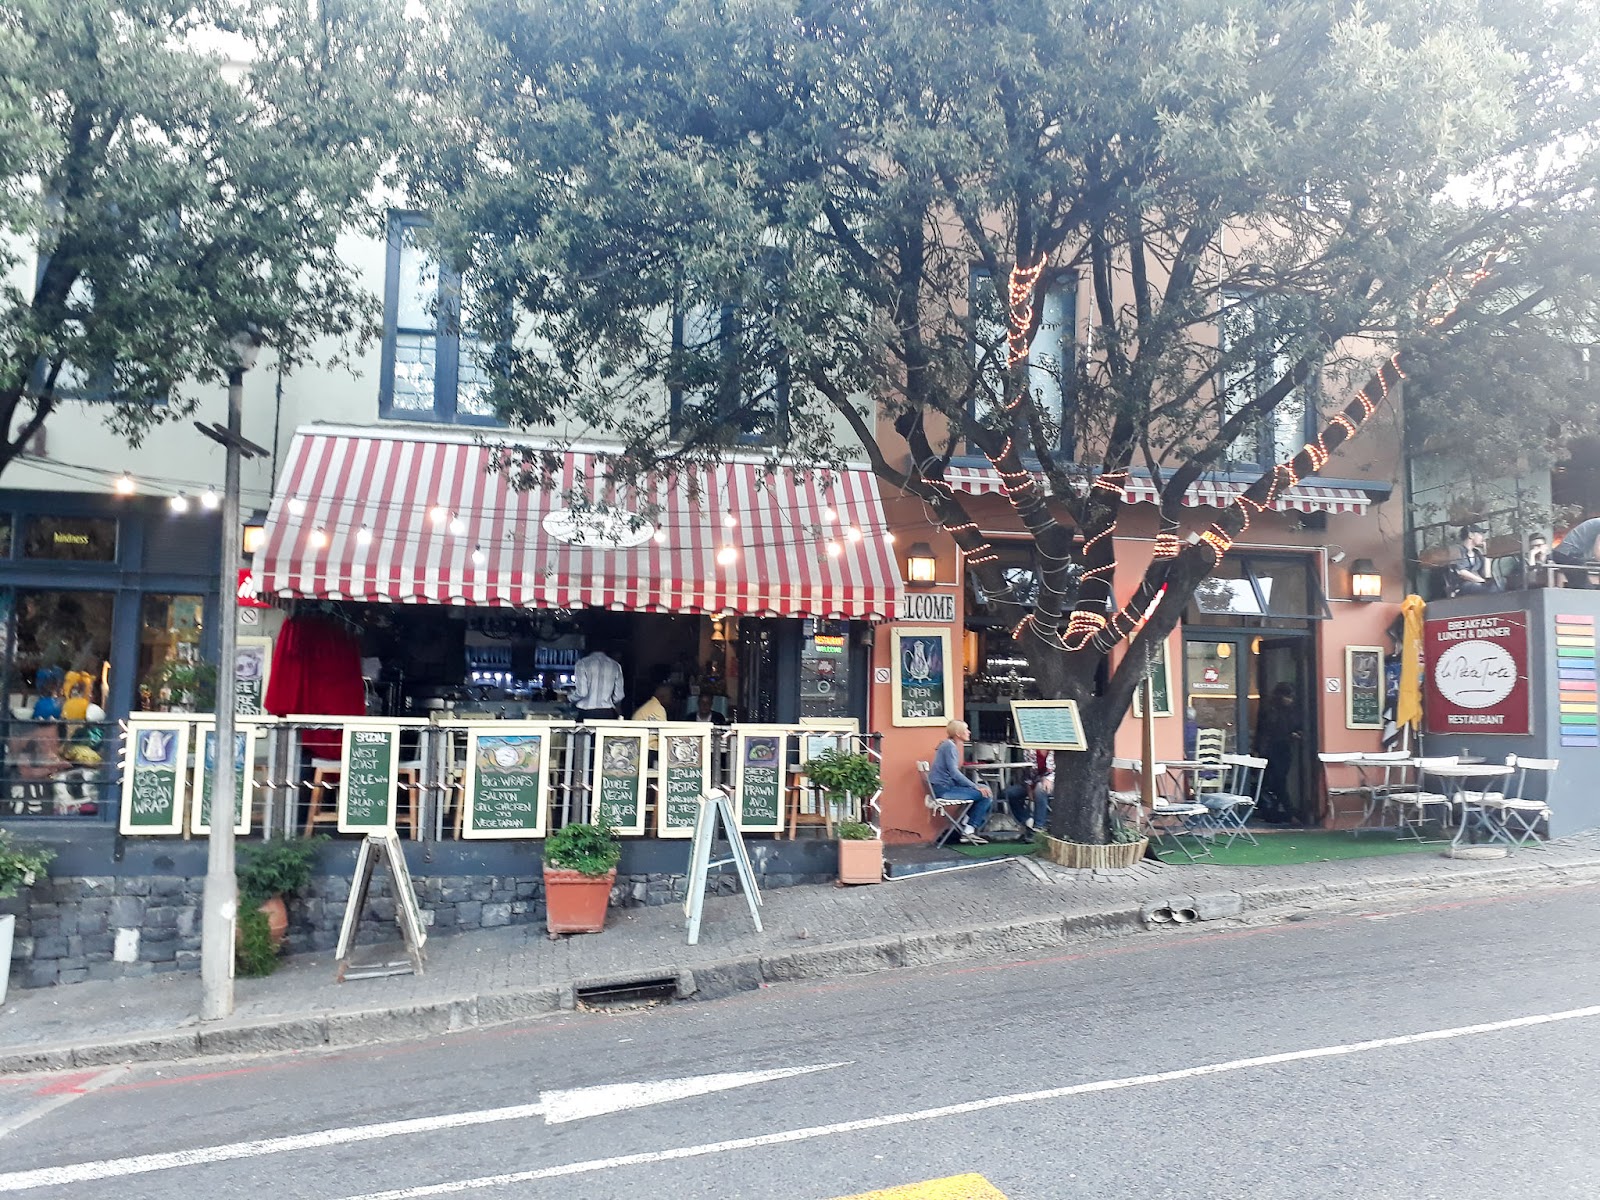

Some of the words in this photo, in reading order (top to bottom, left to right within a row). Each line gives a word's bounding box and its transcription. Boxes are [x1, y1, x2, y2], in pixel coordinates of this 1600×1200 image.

[902, 595, 953, 620] ELCOME
[1447, 619, 1497, 631] BREAKFAST
[1438, 631, 1467, 641] LUNCH
[1468, 630, 1475, 639] &
[1476, 627, 1510, 638] DINNER
[1447, 714, 1504, 725] RESTAURANT
[134, 785, 172, 799] VEGAN
[667, 780, 699, 793] PASTAS
[744, 784, 775, 797] PRAWN
[603, 789, 633, 801] VEGAN
[133, 799, 169, 814] WRAP
